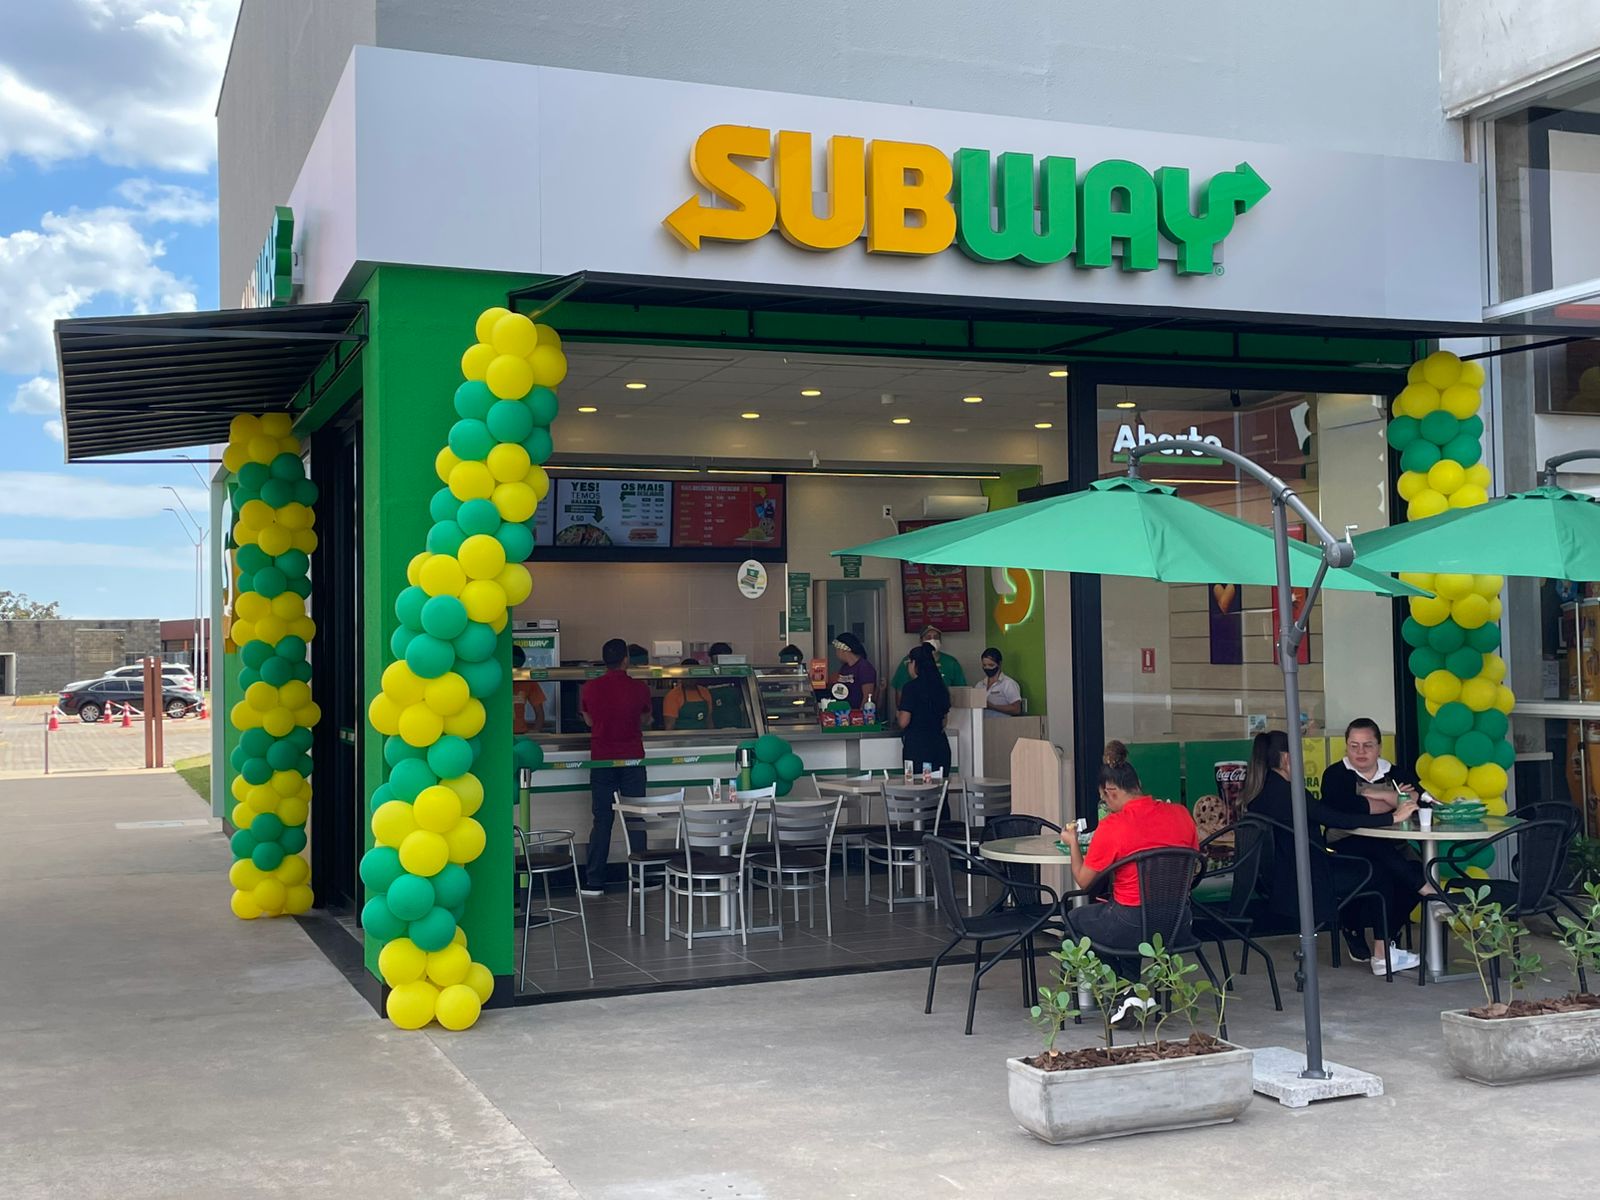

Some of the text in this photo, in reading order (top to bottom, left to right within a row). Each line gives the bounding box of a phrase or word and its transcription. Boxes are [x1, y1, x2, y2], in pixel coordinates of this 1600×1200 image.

[661, 123, 1271, 275] SUBWAY
[571, 481, 599, 492] YES!
[621, 483, 664, 491] OS MAIS
